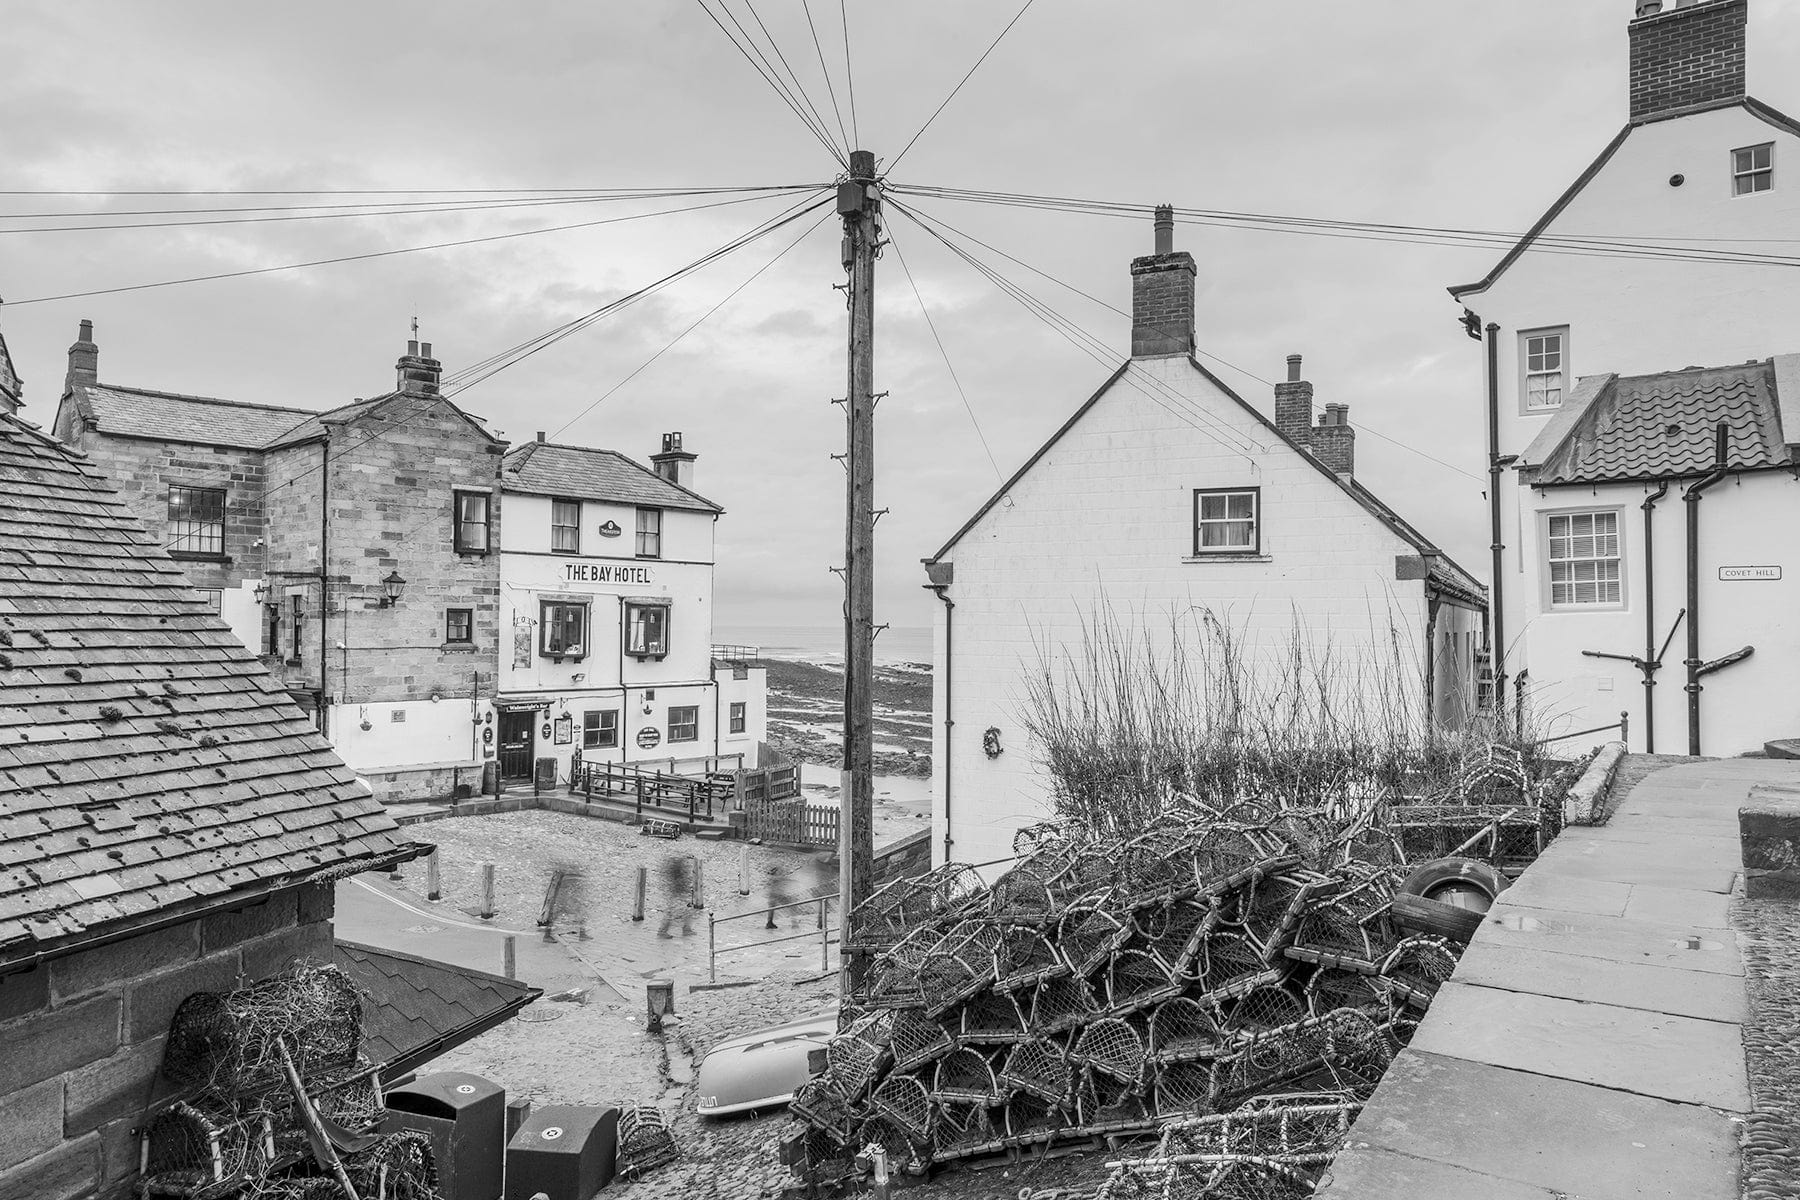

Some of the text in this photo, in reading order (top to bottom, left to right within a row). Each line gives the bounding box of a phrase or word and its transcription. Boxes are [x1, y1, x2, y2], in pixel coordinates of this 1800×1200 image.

[566, 564, 650, 583] THE BAY HOTEL
